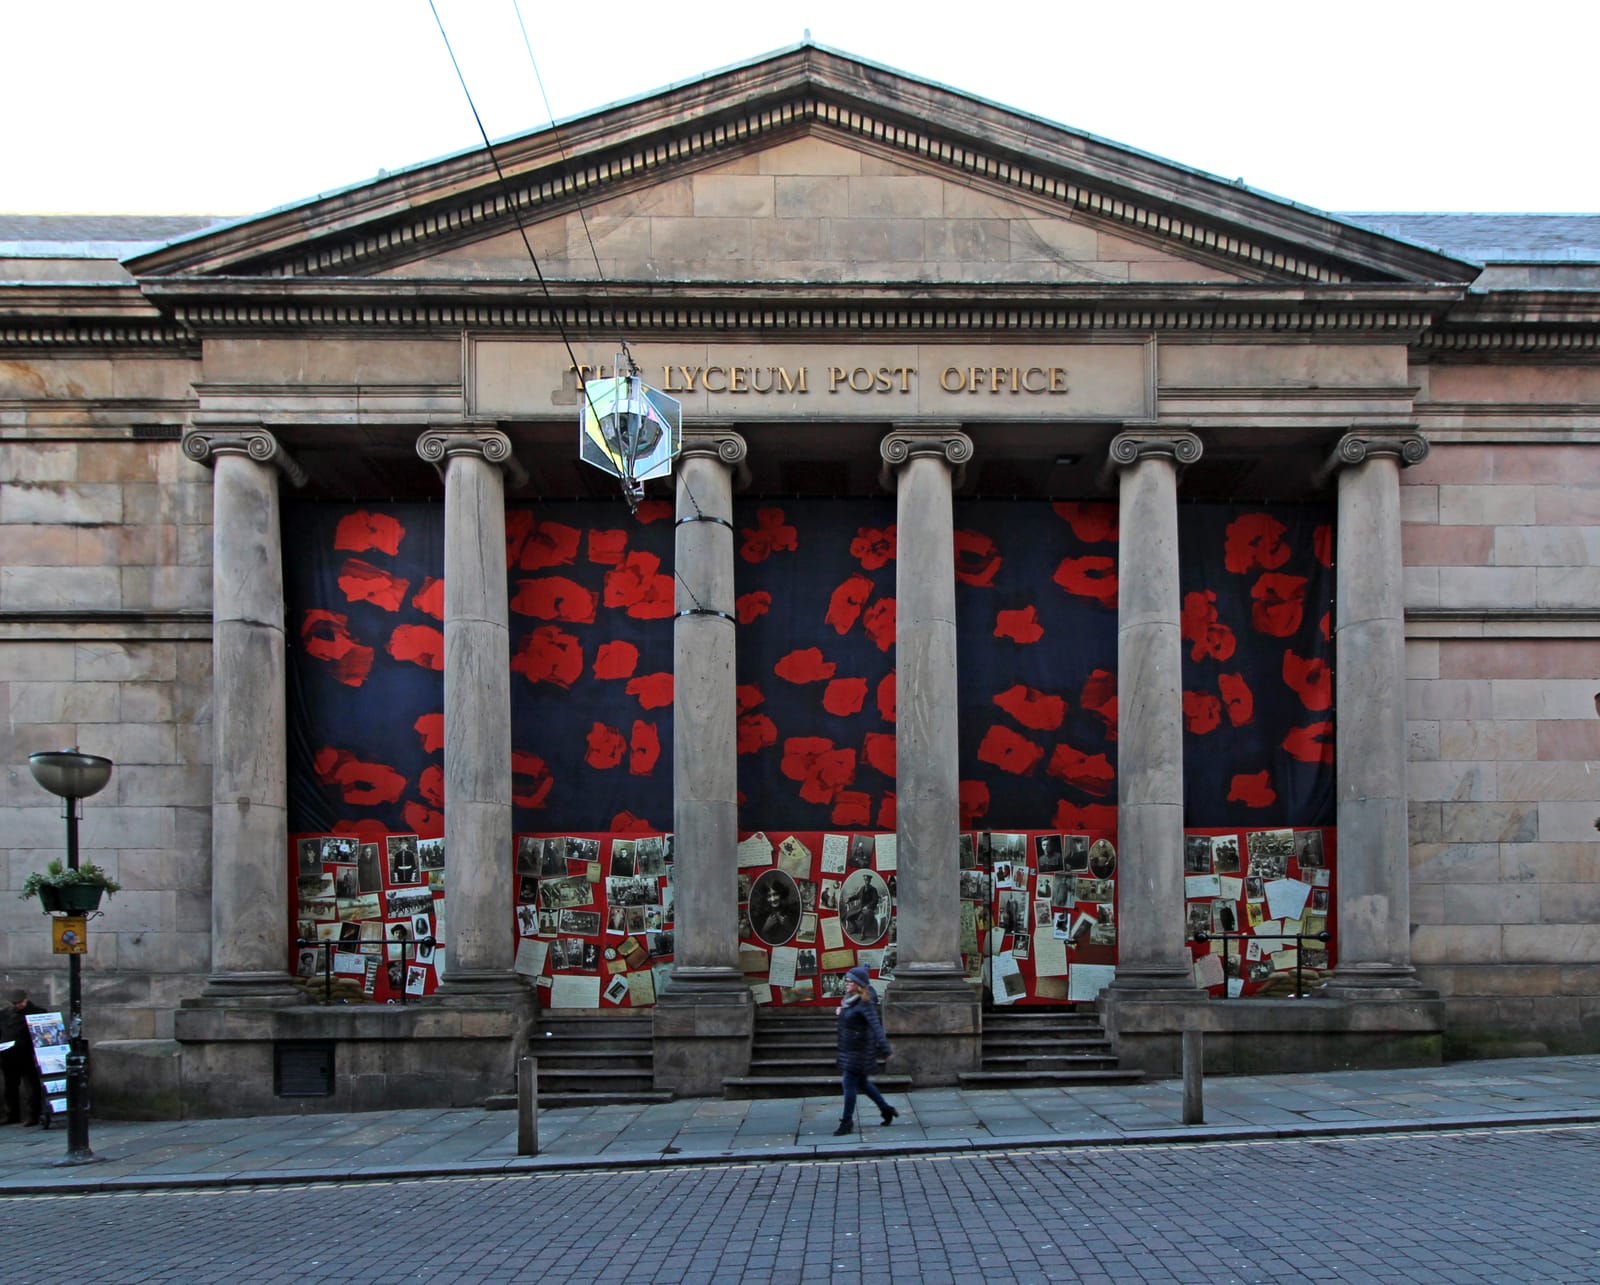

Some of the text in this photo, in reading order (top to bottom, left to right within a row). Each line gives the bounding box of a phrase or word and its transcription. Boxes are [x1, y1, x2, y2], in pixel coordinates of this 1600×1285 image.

[662, 366, 808, 392] LYCEUM
[828, 367, 917, 392] POST
[940, 367, 1068, 392] OFFICE
